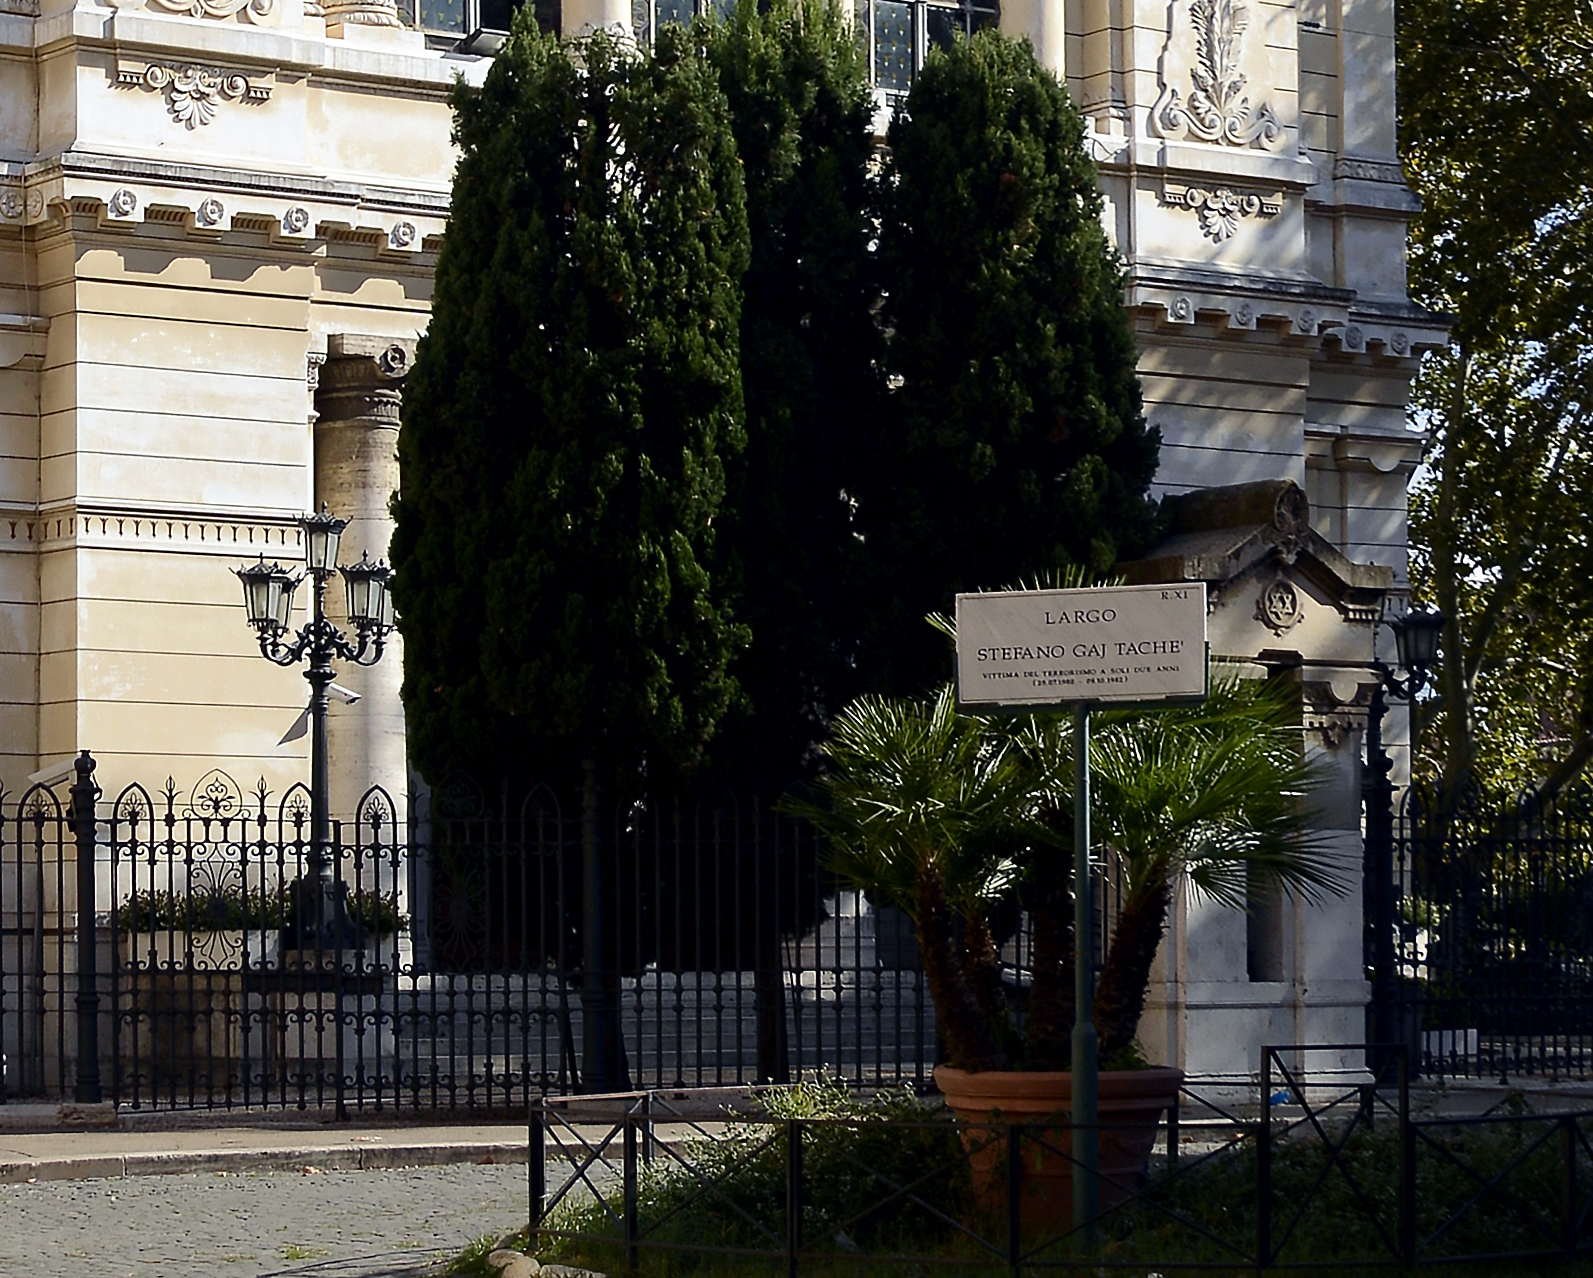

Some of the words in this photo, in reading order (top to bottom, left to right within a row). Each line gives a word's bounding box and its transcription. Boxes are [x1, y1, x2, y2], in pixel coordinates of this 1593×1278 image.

[1045, 609, 1117, 625] LARGO
[977, 645, 1065, 662] STEFANO
[1072, 643, 1106, 660] GAJ
[982, 671, 1019, 680] VITTIMA
[1023, 670, 1039, 678] DEL
[1043, 668, 1097, 677] TERRORISMO
[1156, 665, 1180, 673] ANNI
